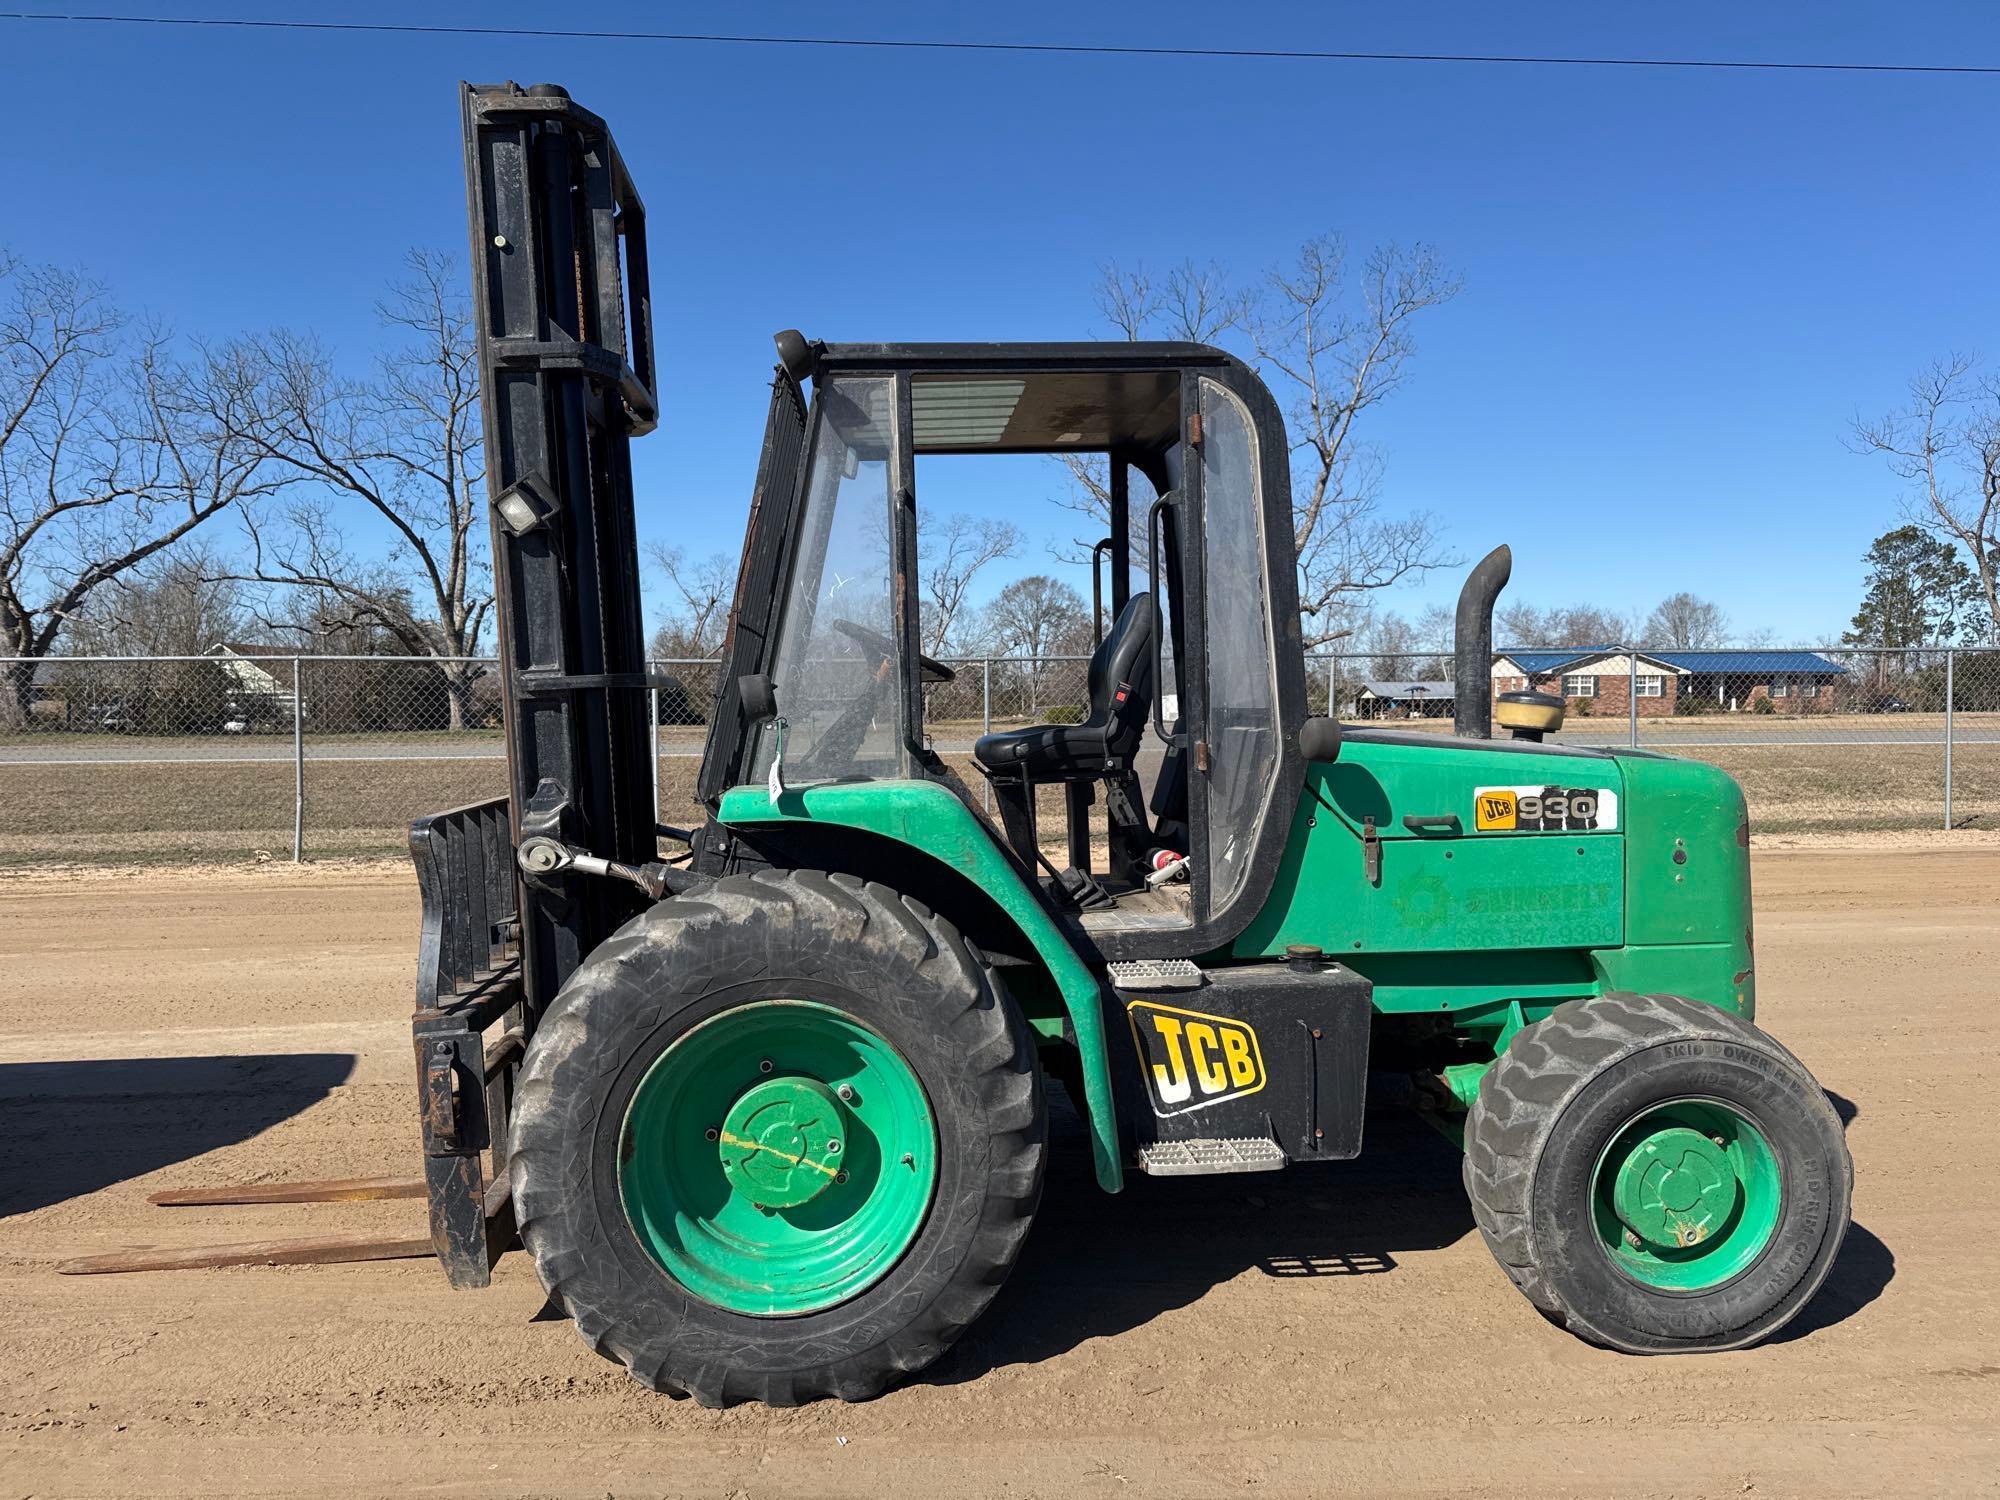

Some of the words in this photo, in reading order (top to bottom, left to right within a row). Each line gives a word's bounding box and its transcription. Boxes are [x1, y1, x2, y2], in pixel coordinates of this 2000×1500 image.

[1485, 799, 1512, 820] JCB
[1518, 796, 1597, 820] 930
[1152, 1014, 1257, 1105] JCB
[1664, 1044, 1704, 1059] SKID
[1712, 1044, 1772, 1072] POWER
[1763, 1240, 1809, 1297] GUARD
